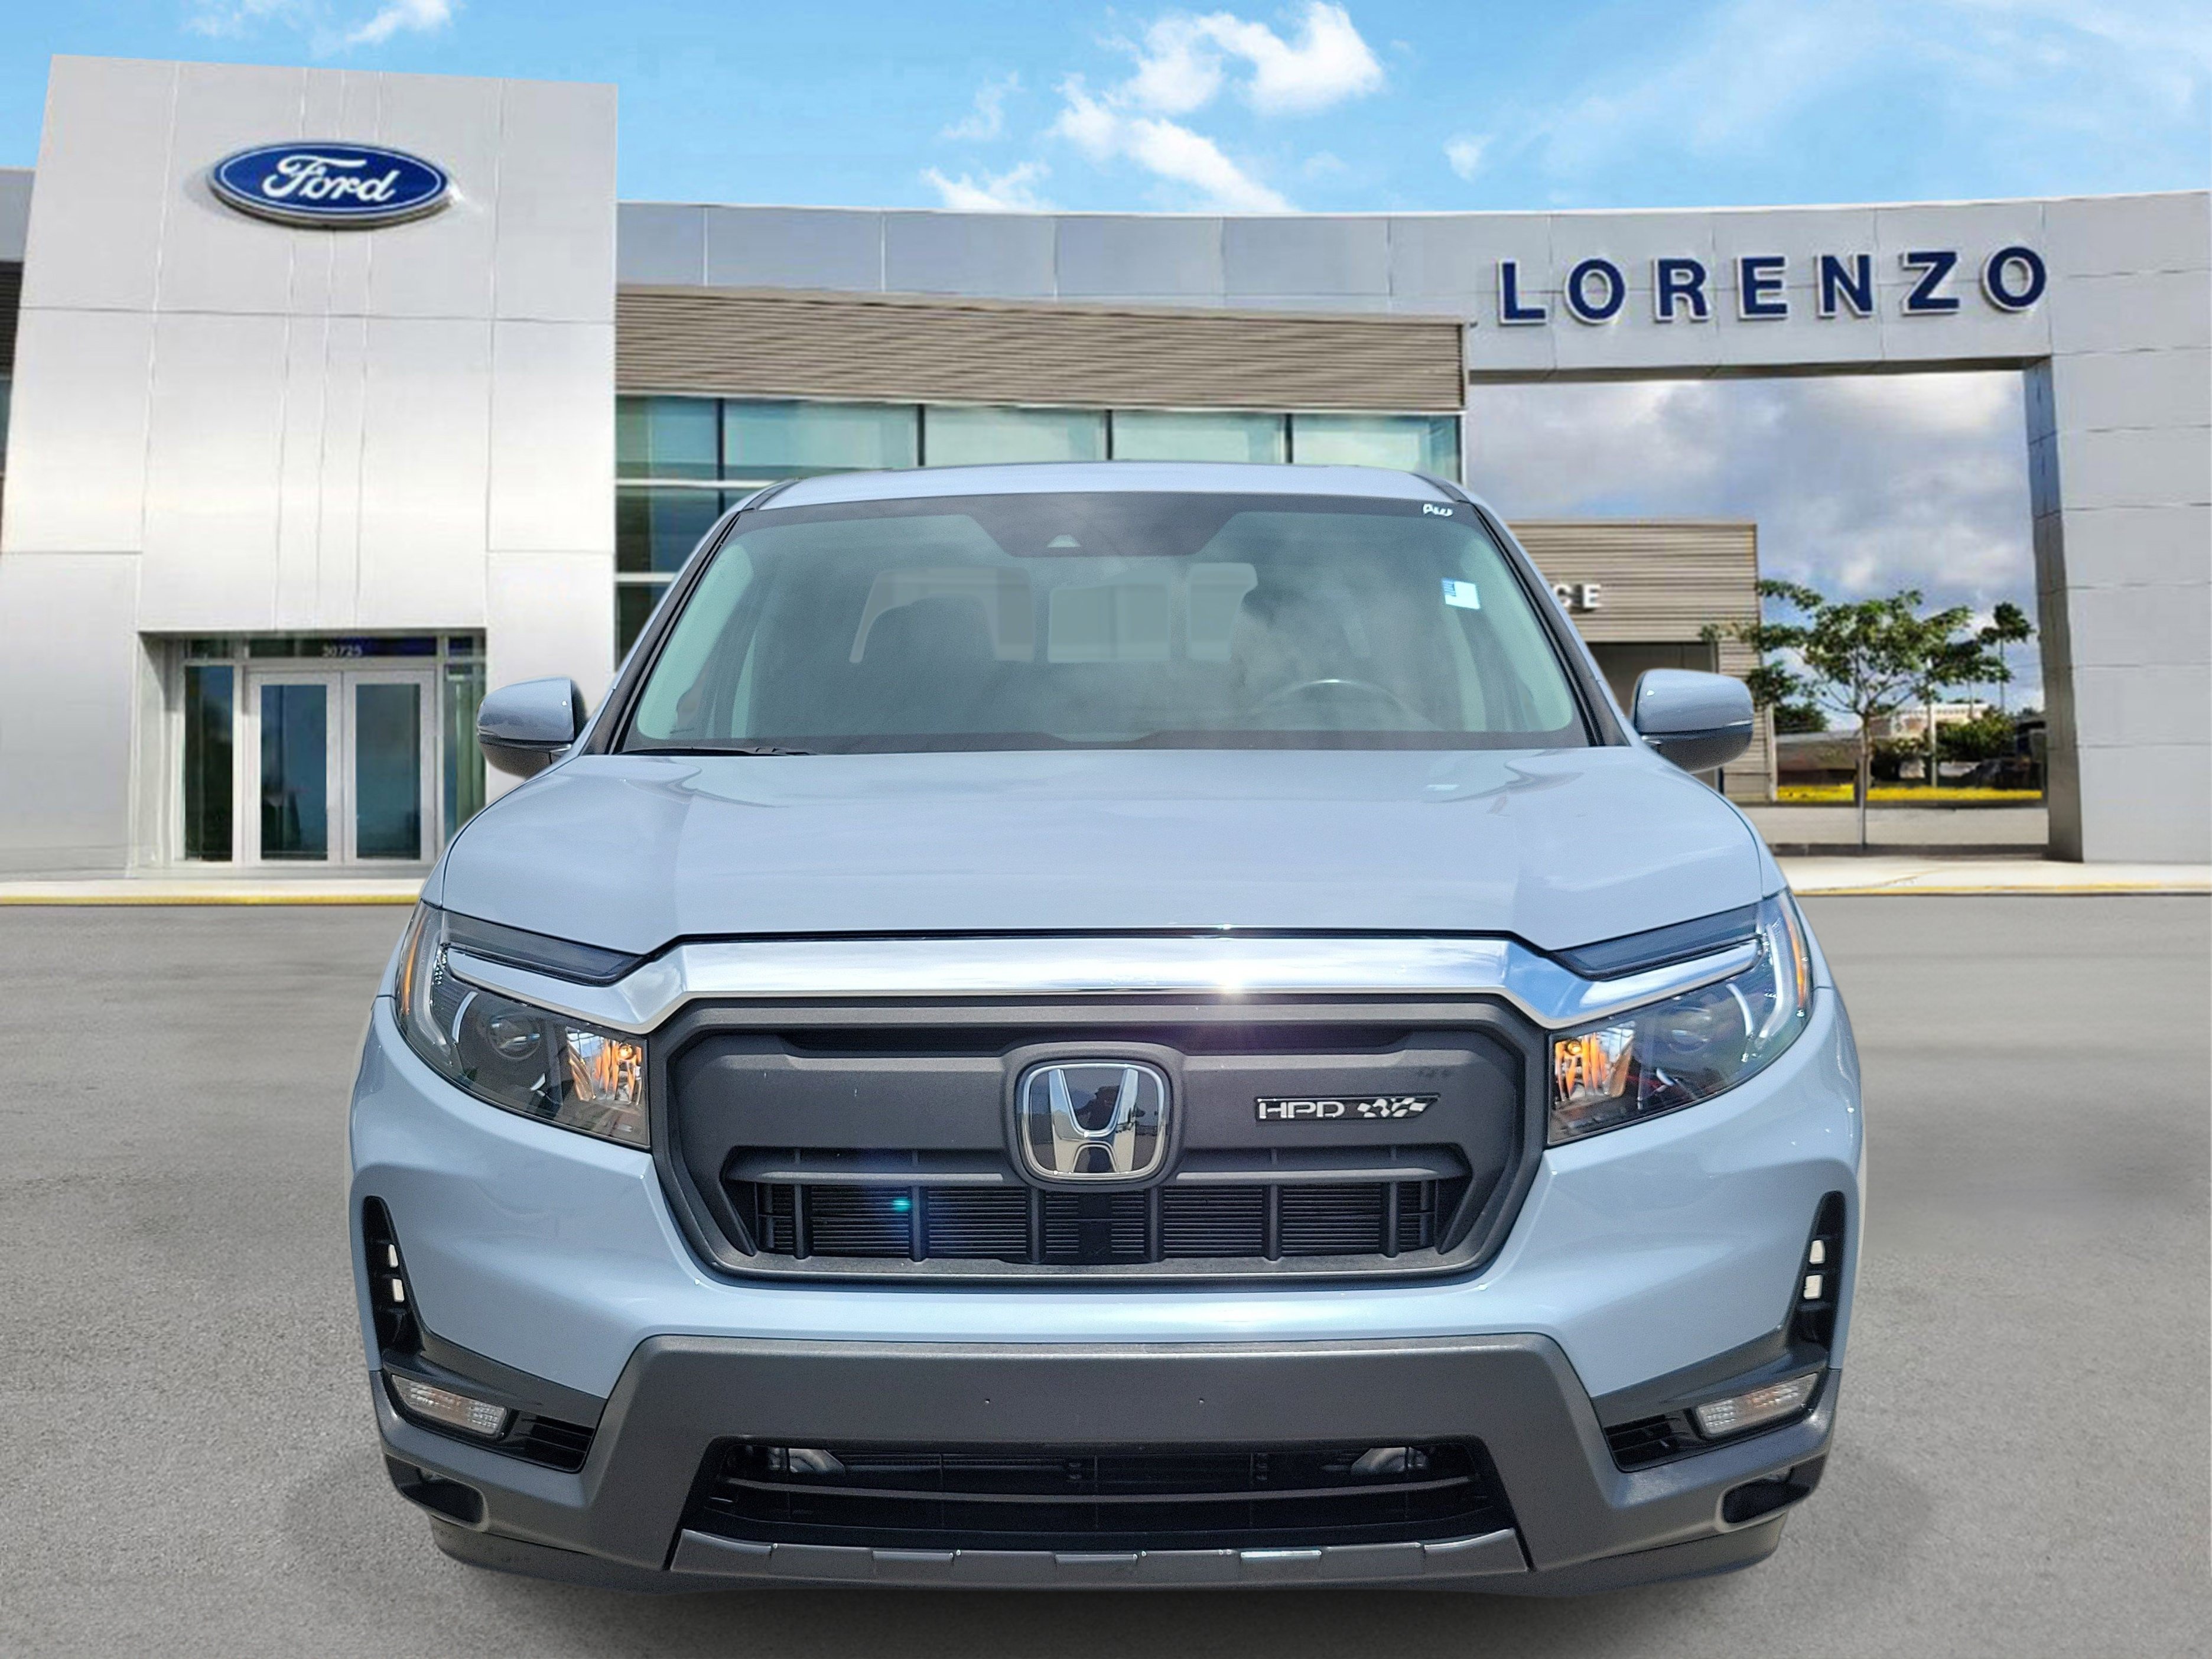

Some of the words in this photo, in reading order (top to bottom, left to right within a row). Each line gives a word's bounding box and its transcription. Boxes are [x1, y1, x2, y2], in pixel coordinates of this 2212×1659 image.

[262, 155, 400, 201] Ford
[1498, 246, 2047, 324] LORENZO
[1259, 1101, 1345, 1118] HPD
